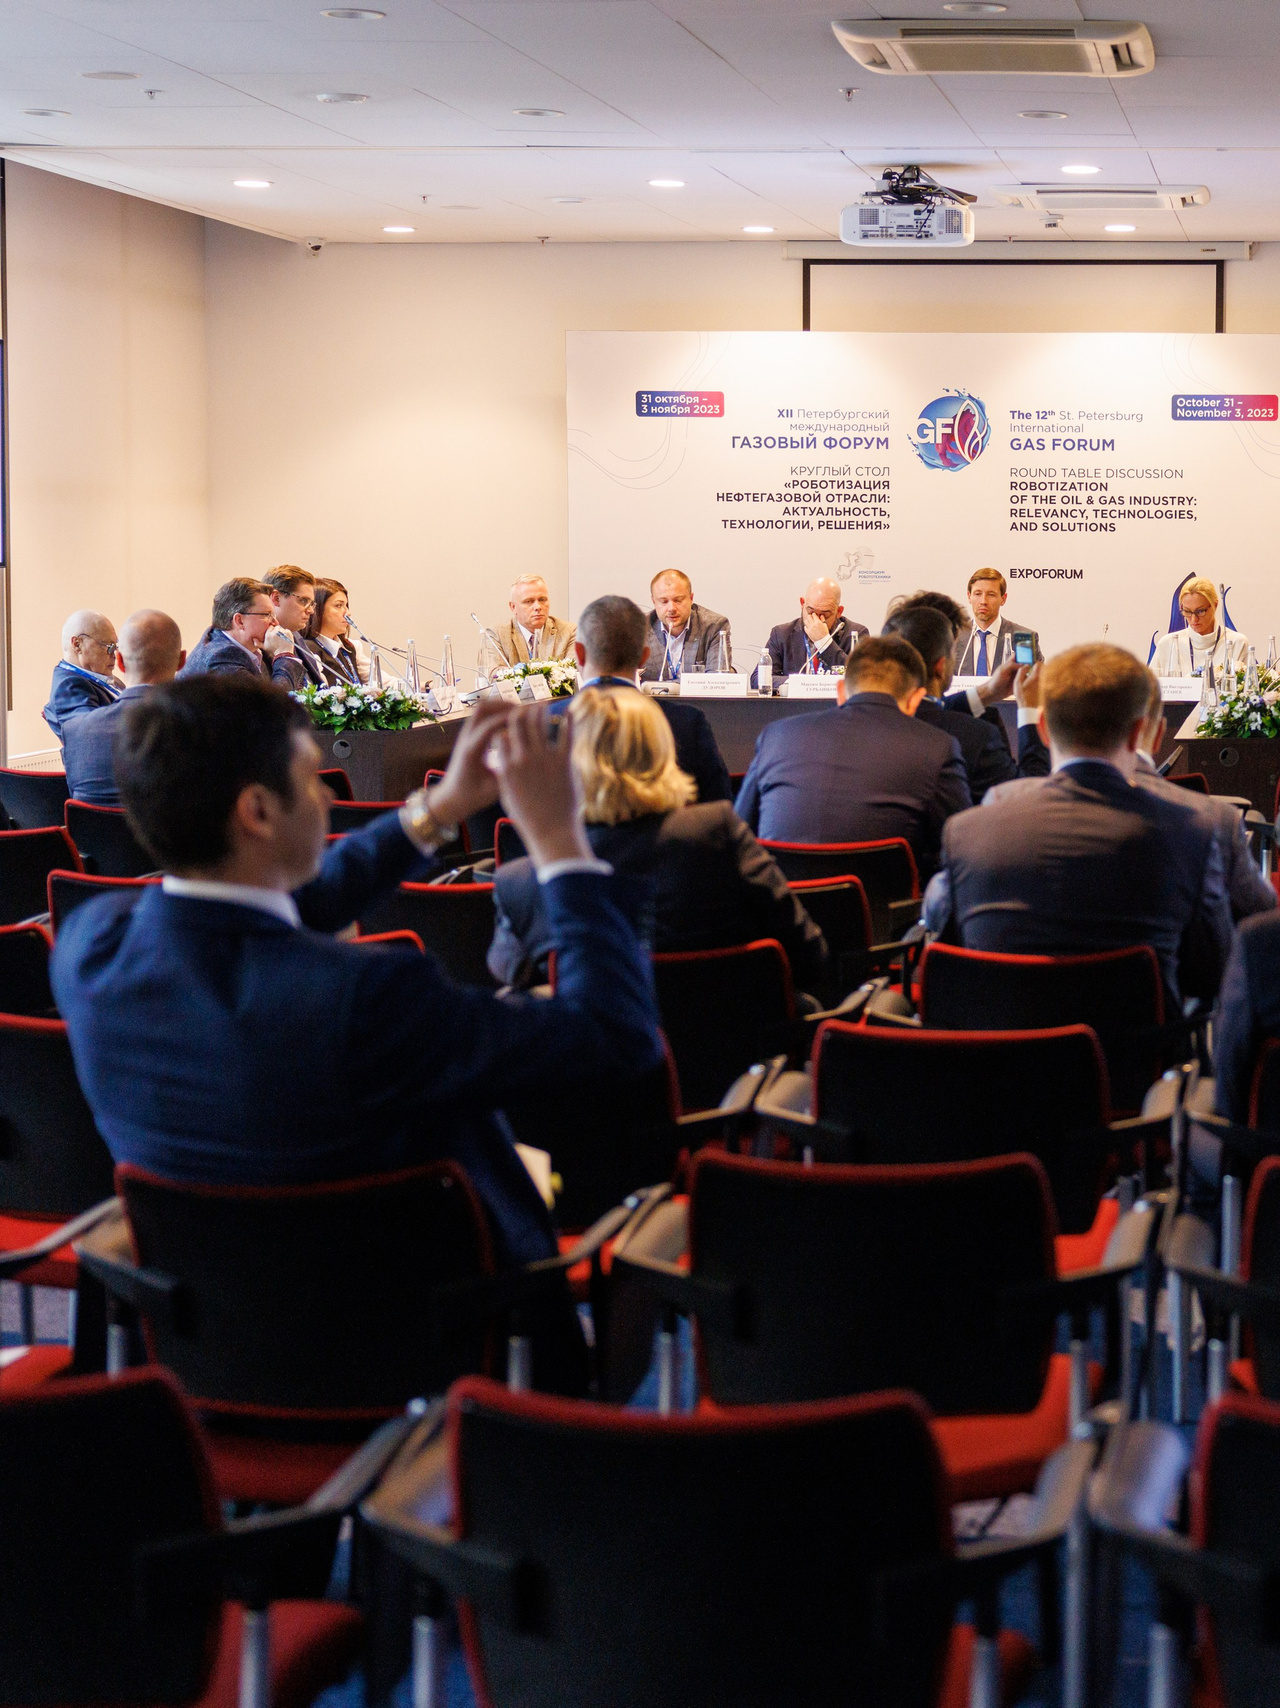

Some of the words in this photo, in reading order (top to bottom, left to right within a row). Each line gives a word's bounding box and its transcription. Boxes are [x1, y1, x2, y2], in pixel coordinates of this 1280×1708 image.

[642, 394, 651, 403] 31
[655, 395, 699, 405] октября
[1177, 398, 1220, 407] October
[1224, 398, 1234, 407] 31
[642, 405, 647, 413] 3
[651, 405, 690, 415] ноября
[694, 405, 719, 413] 2023
[798, 409, 889, 420] Петербургский
[1177, 408, 1232, 417] November
[1235, 409, 1243, 418] 3,
[1247, 409, 1273, 417] 2023
[1010, 410, 1032, 419] The
[1036, 411, 1055, 419] 12th
[1060, 411, 1073, 420] St.
[1079, 411, 1143, 422] Petersburg
[790, 422, 889, 433] международный
[1010, 423, 1083, 433] International
[732, 433, 816, 449] ГАЗОВЫЙ
[823, 437, 888, 449] ФОРУМ
[1010, 438, 1045, 450] GAS
[1053, 439, 1114, 451] FORUM
[791, 465, 850, 476] КРУГЛЫЙ
[856, 467, 889, 476] СТОЛ
[1010, 468, 1056, 477] ROUND
[1061, 468, 1101, 478] TABLE
[1106, 469, 1183, 479] DISCUSSION
[785, 480, 889, 493] «РОБОТИЗАЦИЯ
[1010, 482, 1107, 491] ROBOTIZATION
[717, 491, 820, 502] НЕФТЕГАЗОВОЙ
[826, 494, 890, 503] ОТРАСЛИ:
[1010, 495, 1027, 504] OF
[1032, 495, 1056, 504] THE
[1061, 495, 1082, 504] OIL
[1086, 496, 1094, 505] &
[1099, 496, 1124, 505] GAS
[1130, 496, 1196, 505] INDUSTRY:
[783, 507, 890, 518] АКТУАЛЬНОСТЬ,
[1010, 509, 1088, 520] RELEVANCY,
[1093, 509, 1196, 521] TECHNOLOGIES,
[722, 520, 813, 531] ТЕХНОЛОГИИ,
[818, 521, 890, 530] РЕШЕНИЯ»
[1010, 522, 1037, 531] AND
[1042, 522, 1115, 532] SOLUTIONS
[1010, 569, 1083, 579] EXPOFORUM
